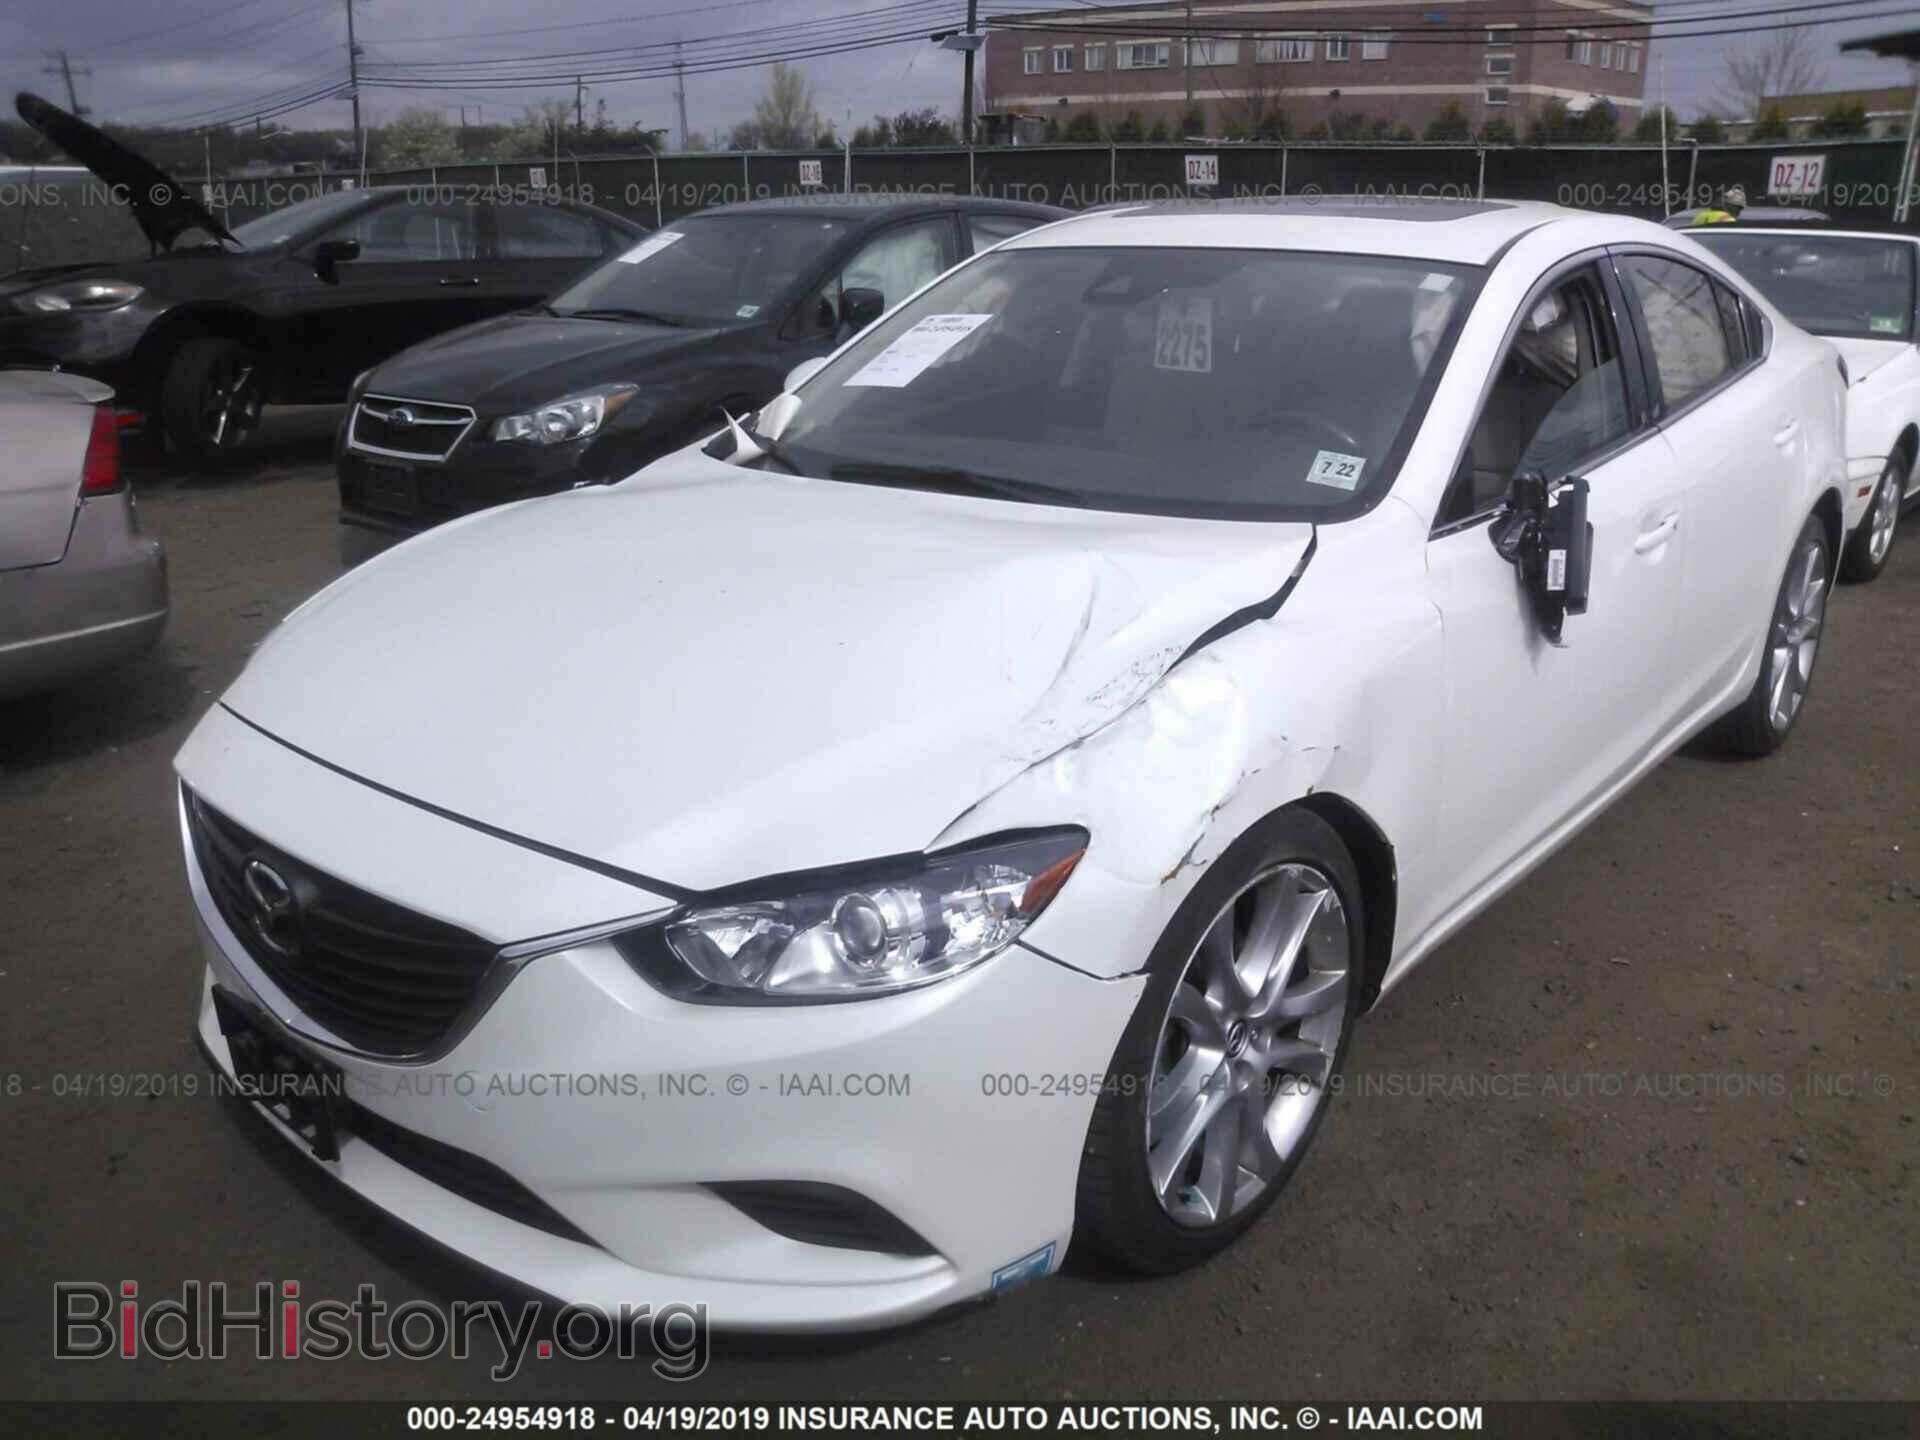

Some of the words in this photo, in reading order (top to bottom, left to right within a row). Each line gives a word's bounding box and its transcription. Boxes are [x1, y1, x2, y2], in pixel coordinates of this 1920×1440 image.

[1188, 160, 1216, 180] DZ-14
[1774, 161, 1819, 189] DZ-12
[1158, 321, 1207, 368] 2275
[1322, 461, 1333, 474] 7
[1336, 463, 1356, 478] 22
